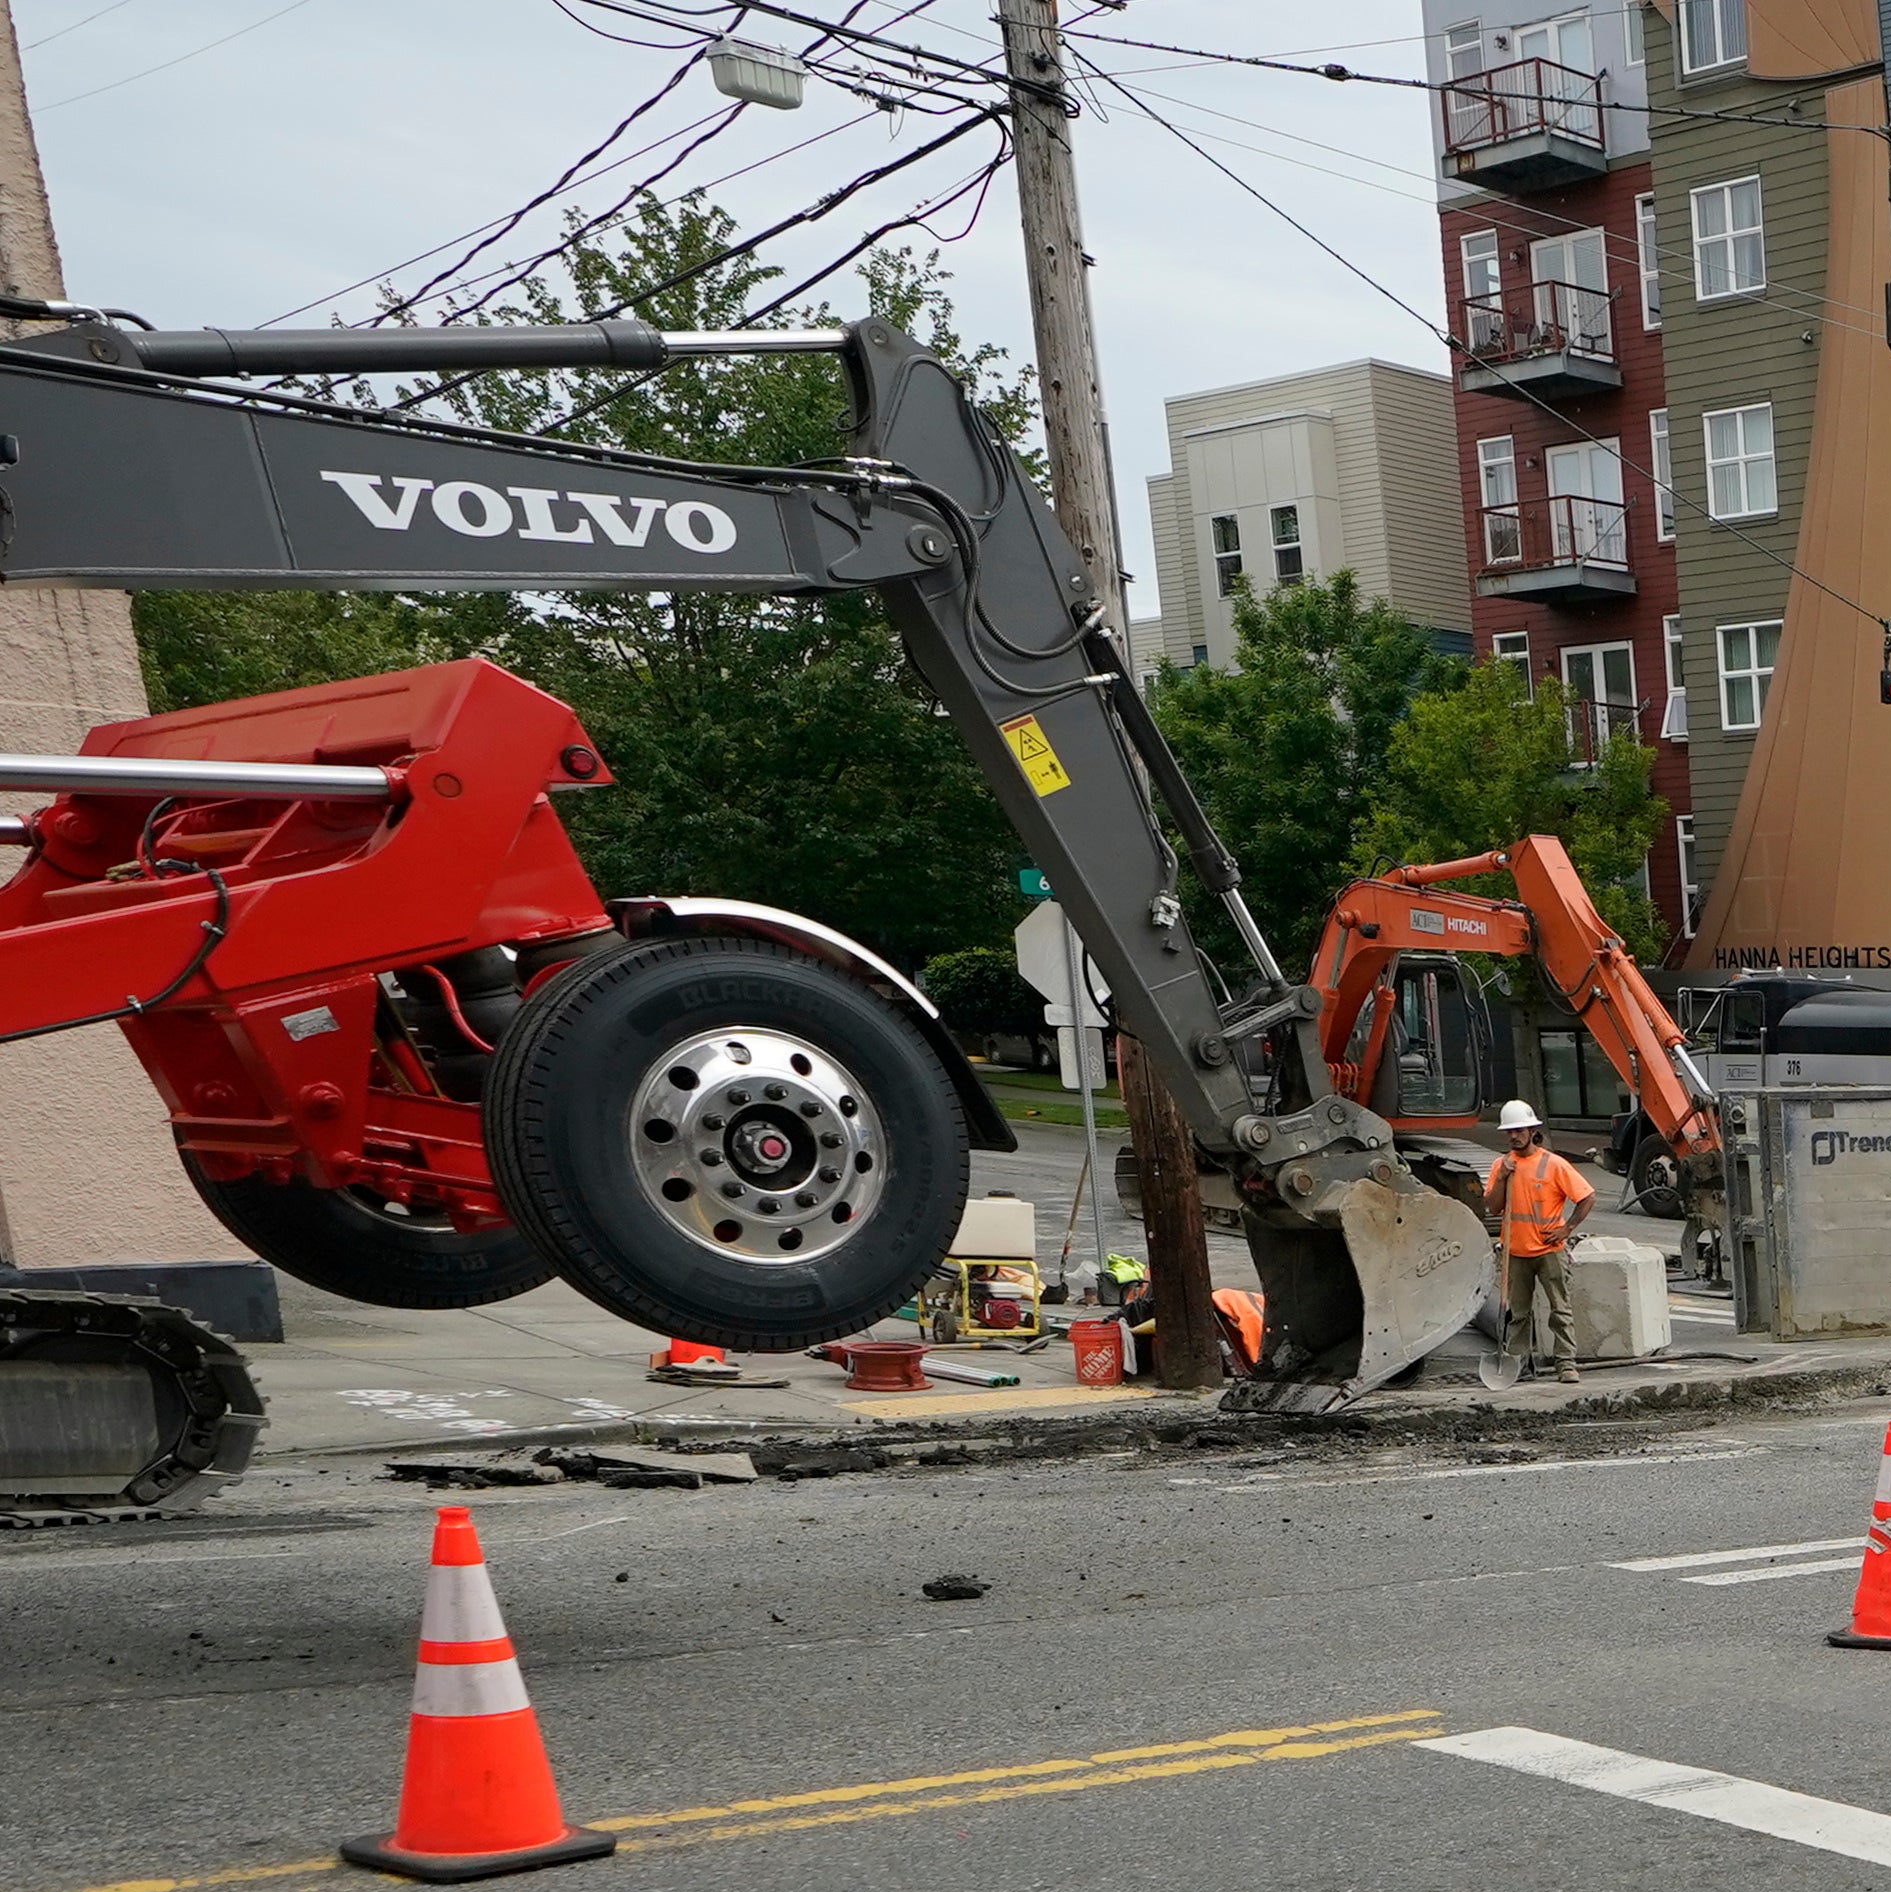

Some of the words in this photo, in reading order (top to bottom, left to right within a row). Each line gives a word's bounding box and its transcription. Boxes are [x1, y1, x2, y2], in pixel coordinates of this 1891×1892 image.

[320, 470, 738, 554] VOLVO
[1447, 917, 1487, 935] HITACHI
[1715, 947, 1781, 969] HANNA
[1789, 946, 1891, 969] HEIGHTS
[1787, 1060, 1801, 1076] 376
[1081, 1345, 1114, 1378] HOME
